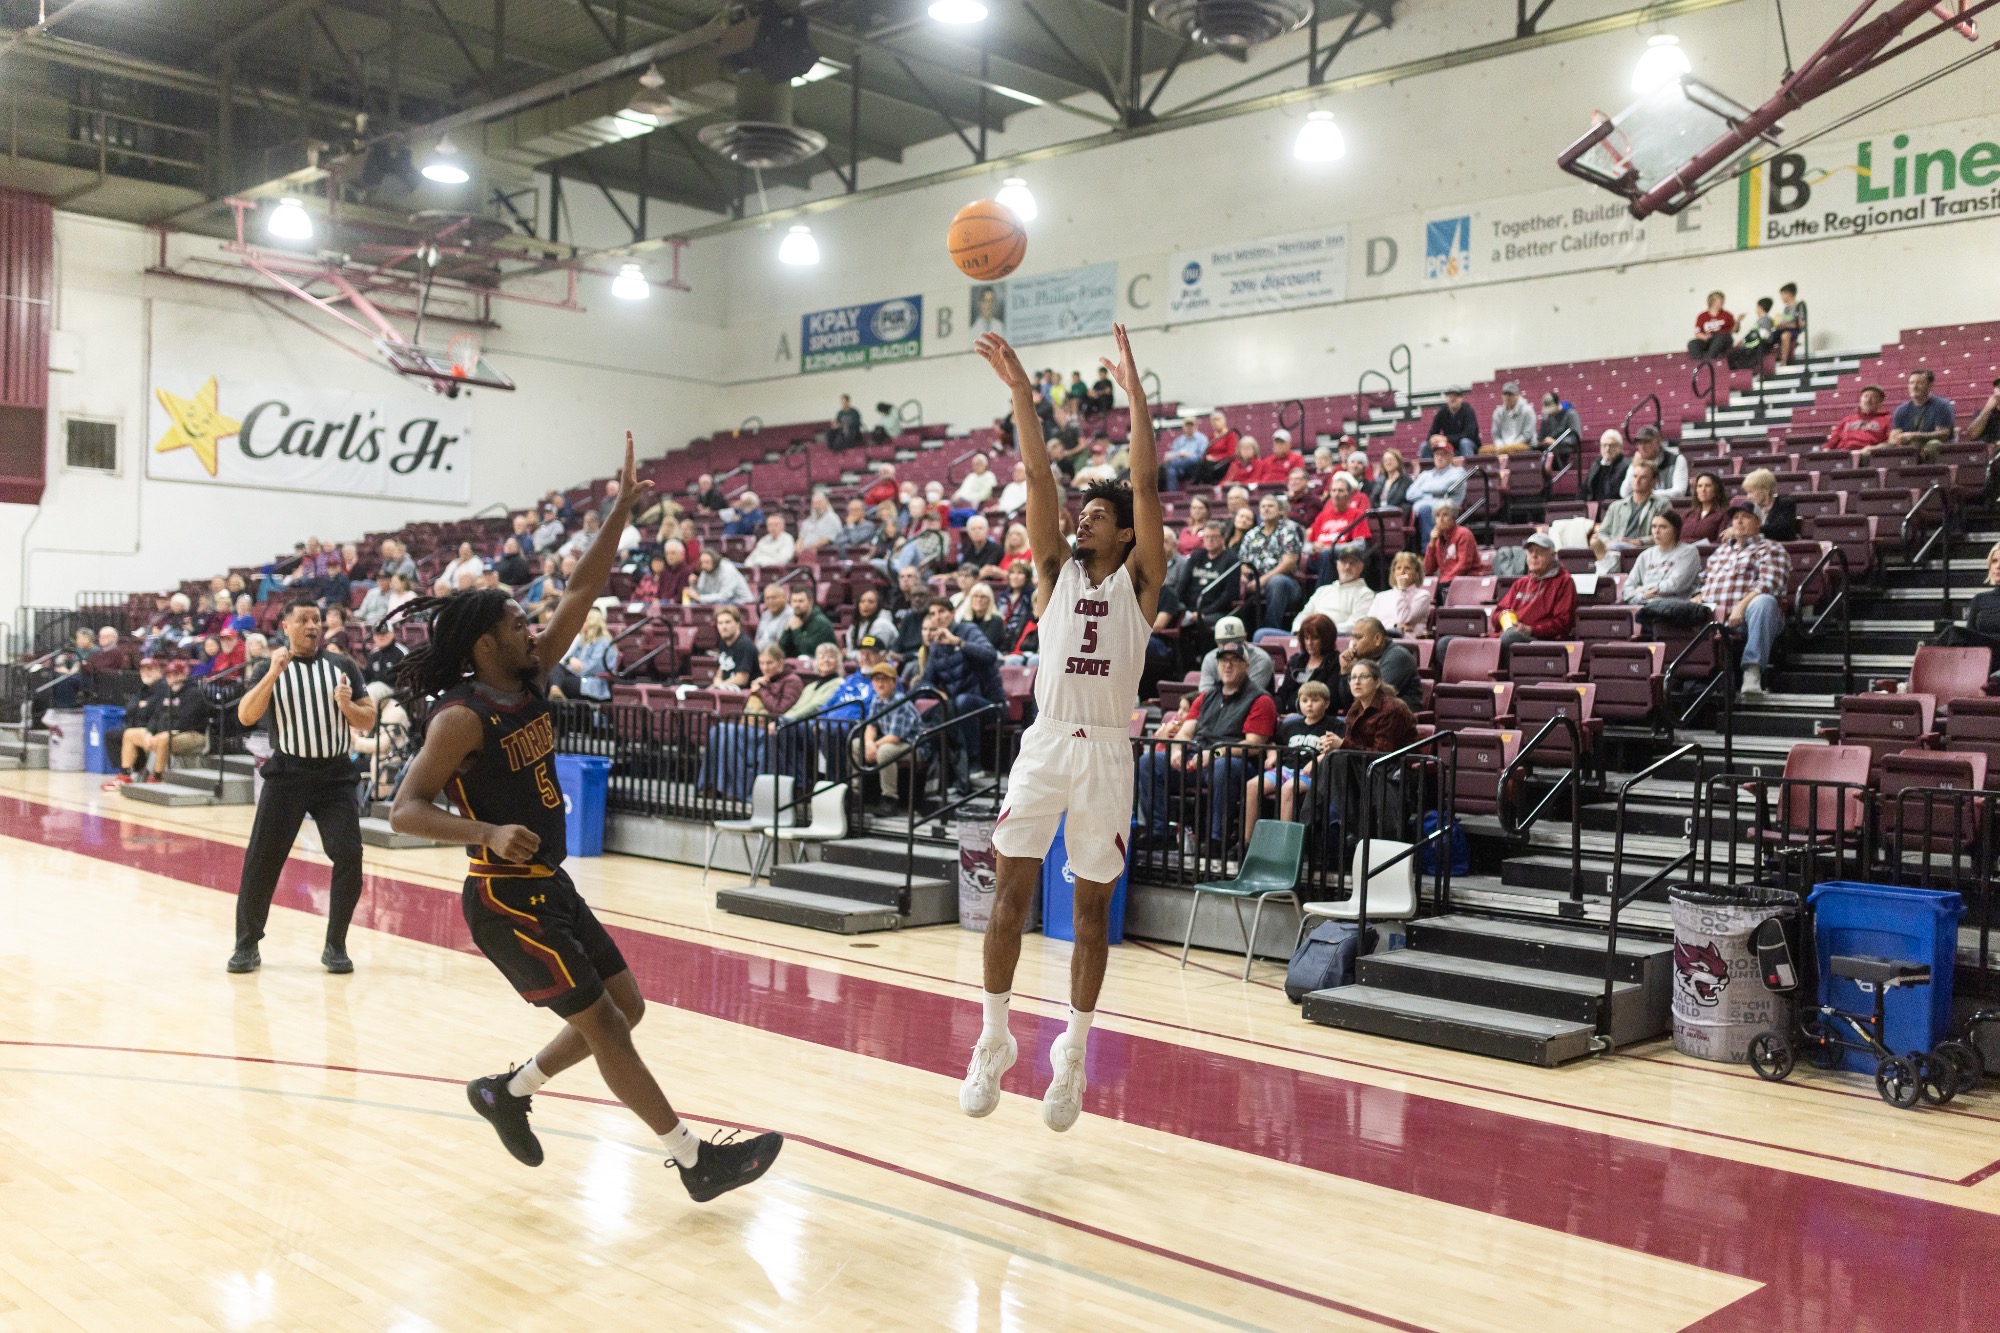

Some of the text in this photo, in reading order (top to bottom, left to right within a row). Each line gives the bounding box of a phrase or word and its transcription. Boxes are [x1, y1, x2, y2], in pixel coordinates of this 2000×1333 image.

[1767, 134, 2000, 215] B Line
[1492, 213, 1568, 238] Together,
[1767, 219, 1819, 240] Butte
[1824, 198, 1926, 233] Regional
[1366, 236, 1398, 277] D
[1491, 225, 1646, 263] a Better California
[1127, 273, 1151, 310] C
[1260, 269, 1322, 290] discount
[809, 308, 861, 334] KPAY
[936, 307, 954, 339] B
[775, 331, 791, 361] A
[238, 400, 459, 474] Carl's Jr.
[1080, 621, 1097, 653] 5
[1065, 657, 1111, 676] STATE
[1477, 753, 1488, 763] 42
[534, 762, 560, 809] 5
[1685, 818, 1692, 835] C
